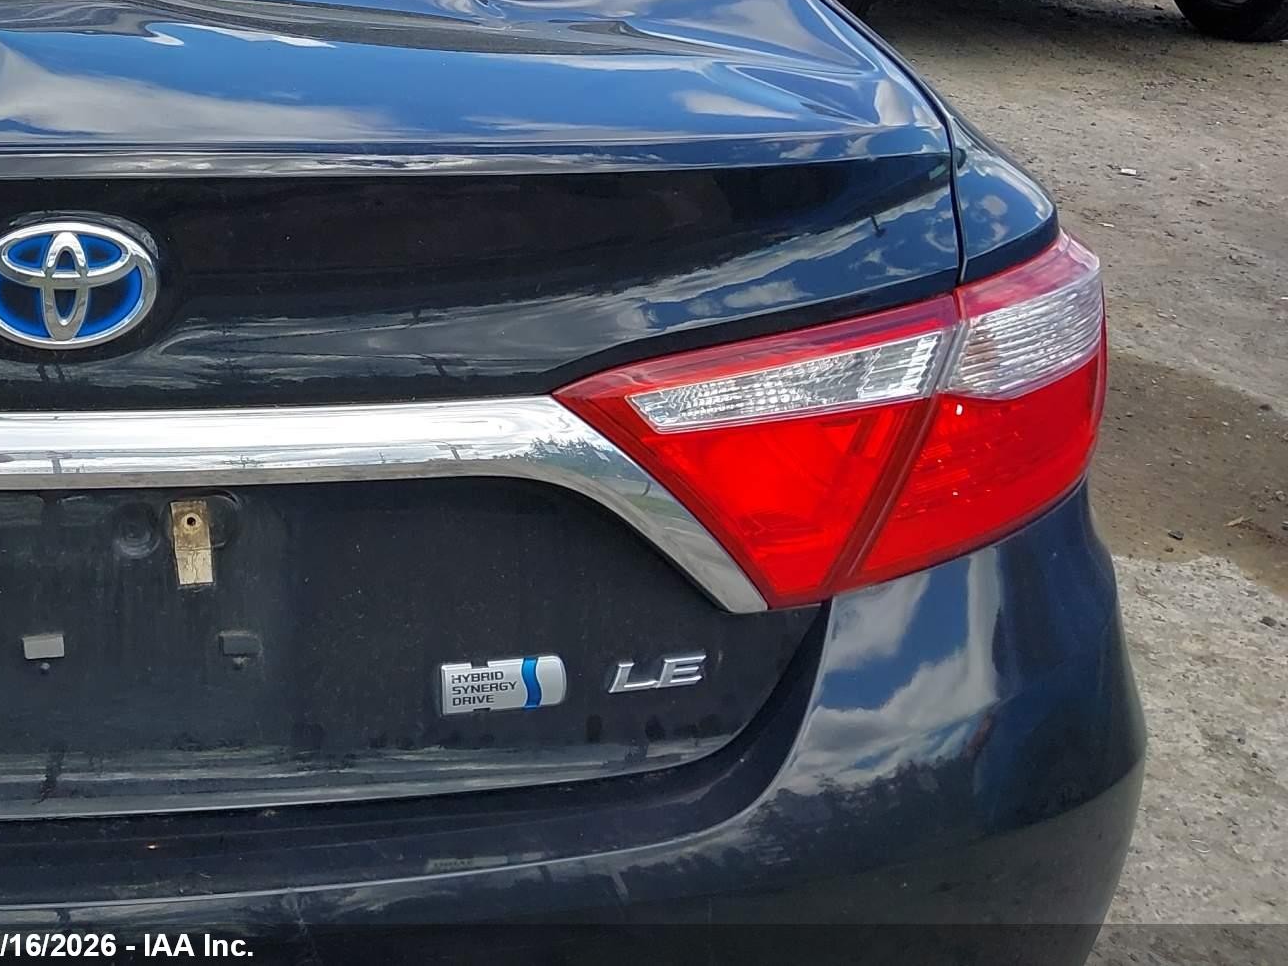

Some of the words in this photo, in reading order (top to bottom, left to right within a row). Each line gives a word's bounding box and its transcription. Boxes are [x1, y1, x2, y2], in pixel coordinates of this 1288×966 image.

[451, 670, 505, 685] HYBRID
[608, 654, 707, 694] LE
[451, 681, 518, 696] SYNERGY
[452, 694, 495, 707] DRIVE
